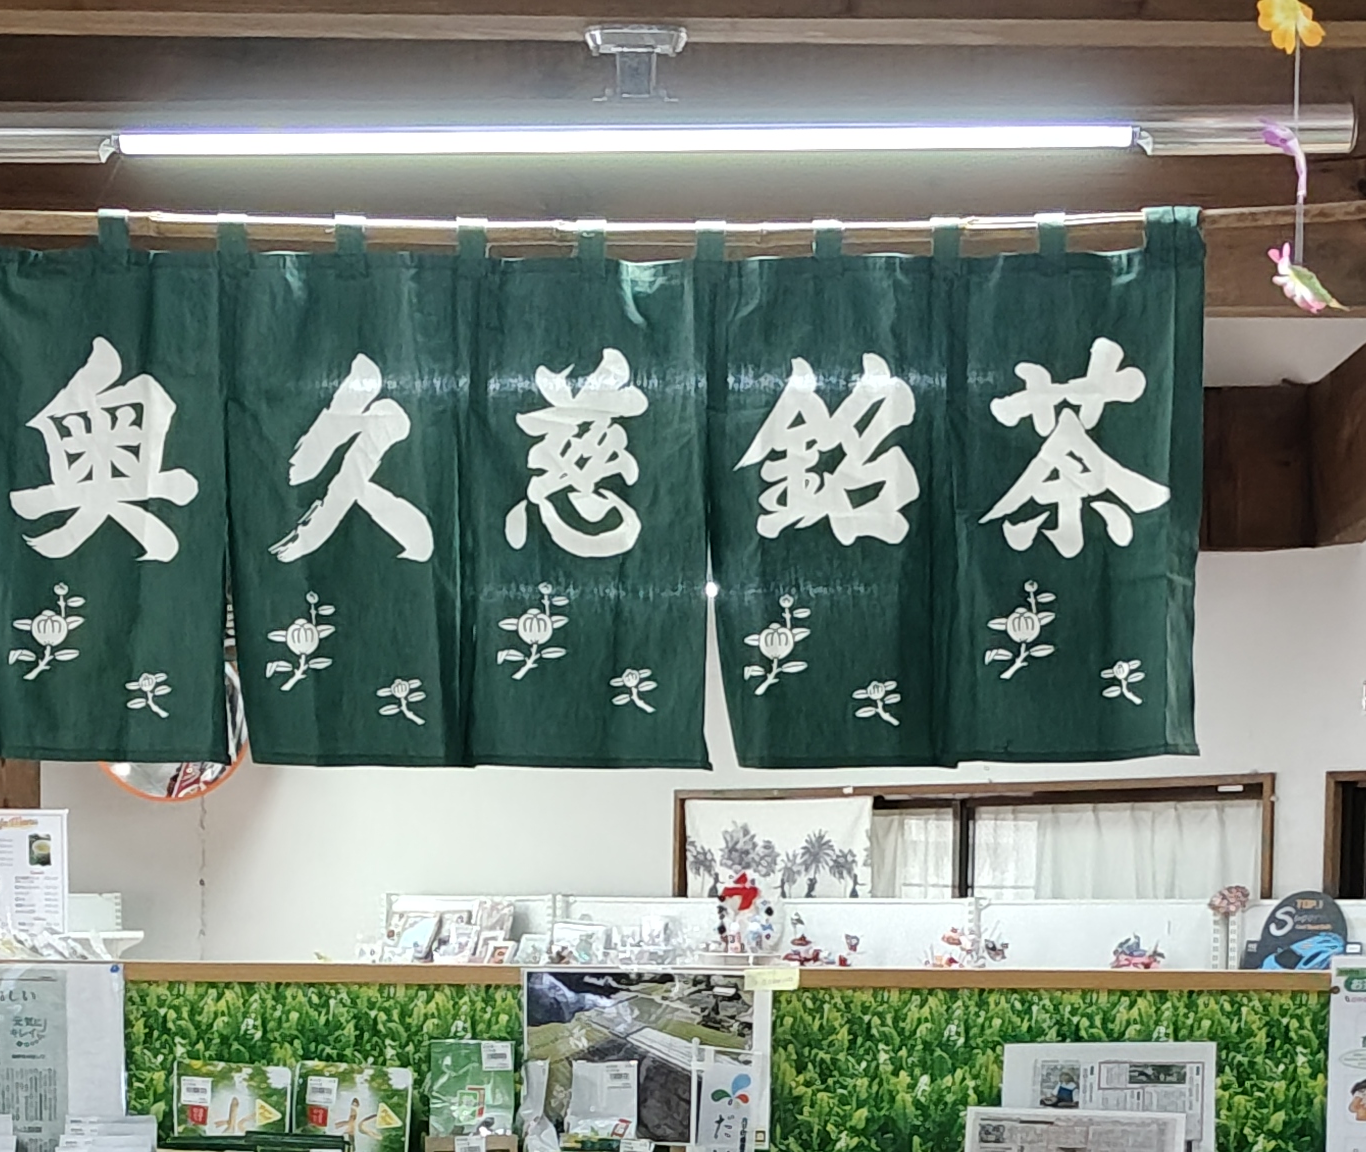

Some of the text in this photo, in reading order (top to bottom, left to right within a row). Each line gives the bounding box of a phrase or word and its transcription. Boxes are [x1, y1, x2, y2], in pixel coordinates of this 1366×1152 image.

[10, 336, 1170, 562] 奥久慈銘茶
